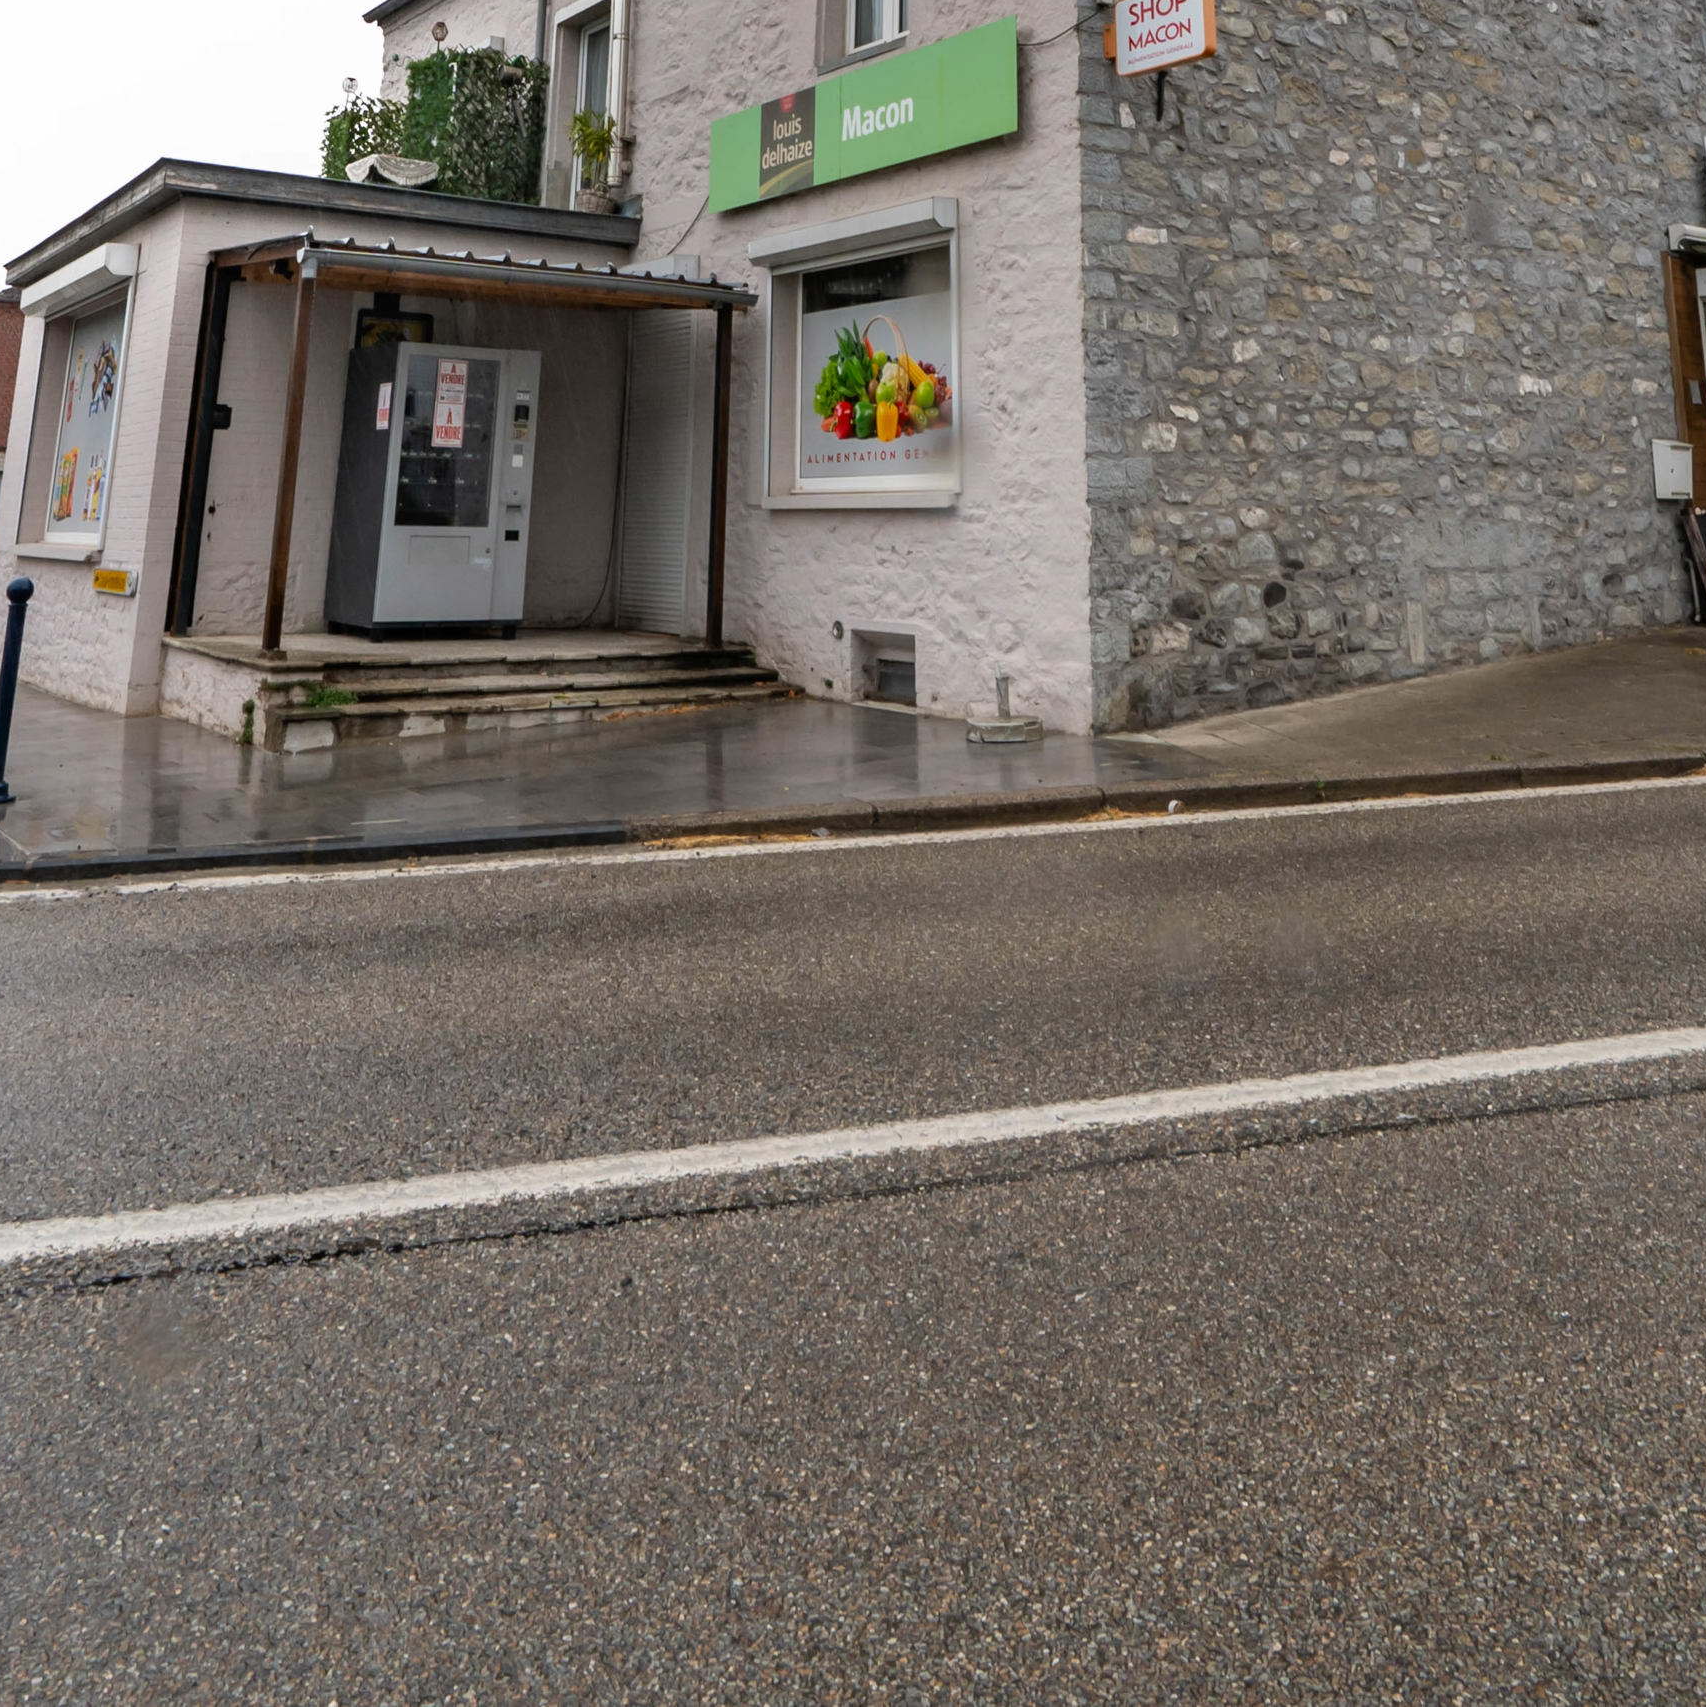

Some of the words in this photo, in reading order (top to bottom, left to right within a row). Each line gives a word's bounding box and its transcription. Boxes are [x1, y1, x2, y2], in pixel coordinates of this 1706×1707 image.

[1128, 17, 1192, 52] MACON
[773, 113, 803, 141] louis
[841, 97, 914, 142] Macon
[761, 138, 813, 170] delhaize
[440, 374, 465, 385] VENDRE
[435, 425, 462, 440] VENDRE
[807, 450, 897, 464] ALIMENTATION
